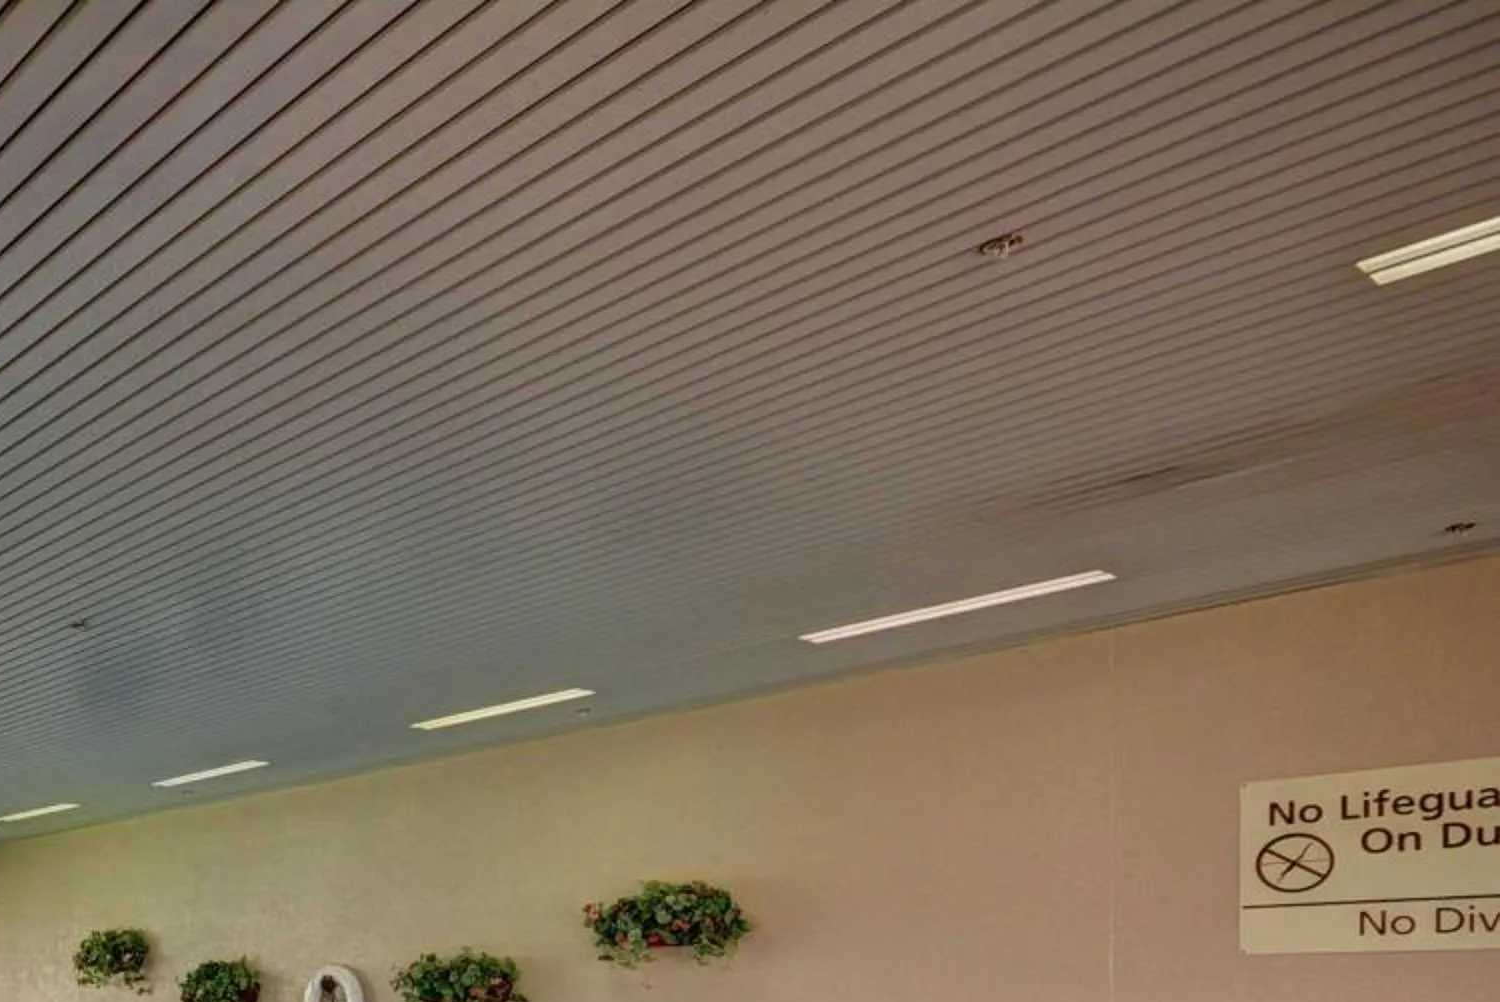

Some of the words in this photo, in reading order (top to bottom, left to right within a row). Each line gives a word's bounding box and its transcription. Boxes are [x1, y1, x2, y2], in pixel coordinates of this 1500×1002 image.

[1269, 801, 1323, 826] No
[1341, 787, 1500, 821] Lifegua
[1361, 828, 1422, 854] On
[1442, 822, 1500, 849] Du
[1359, 910, 1416, 936] No
[1435, 905, 1500, 934] Div
